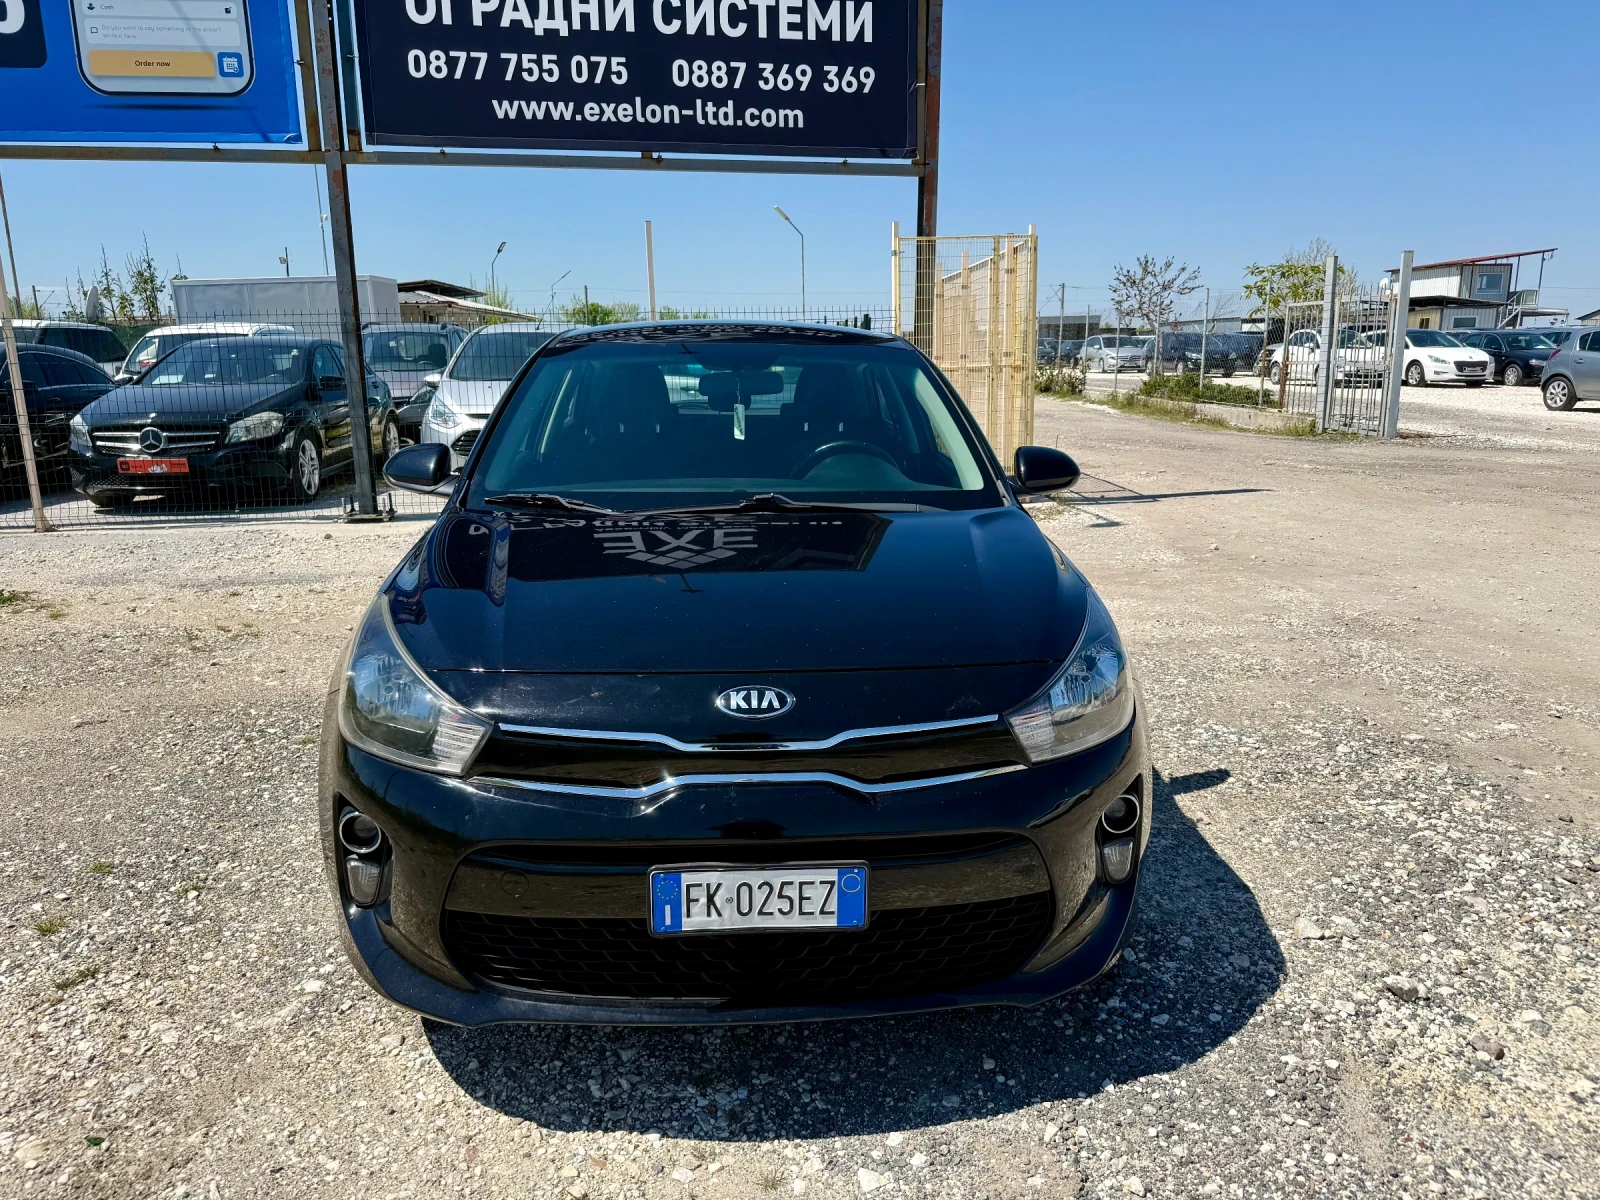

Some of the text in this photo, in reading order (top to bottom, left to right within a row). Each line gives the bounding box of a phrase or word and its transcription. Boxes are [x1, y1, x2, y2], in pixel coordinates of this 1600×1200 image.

[652, 0, 873, 43] СИСТЕМИ
[407, 49, 876, 94] 0877 755 075 0887 369 369
[492, 96, 804, 128] www.exelon-ltd.com
[730, 690, 780, 709] KIA
[685, 882, 723, 918] FK
[735, 880, 836, 917] 025EZ
